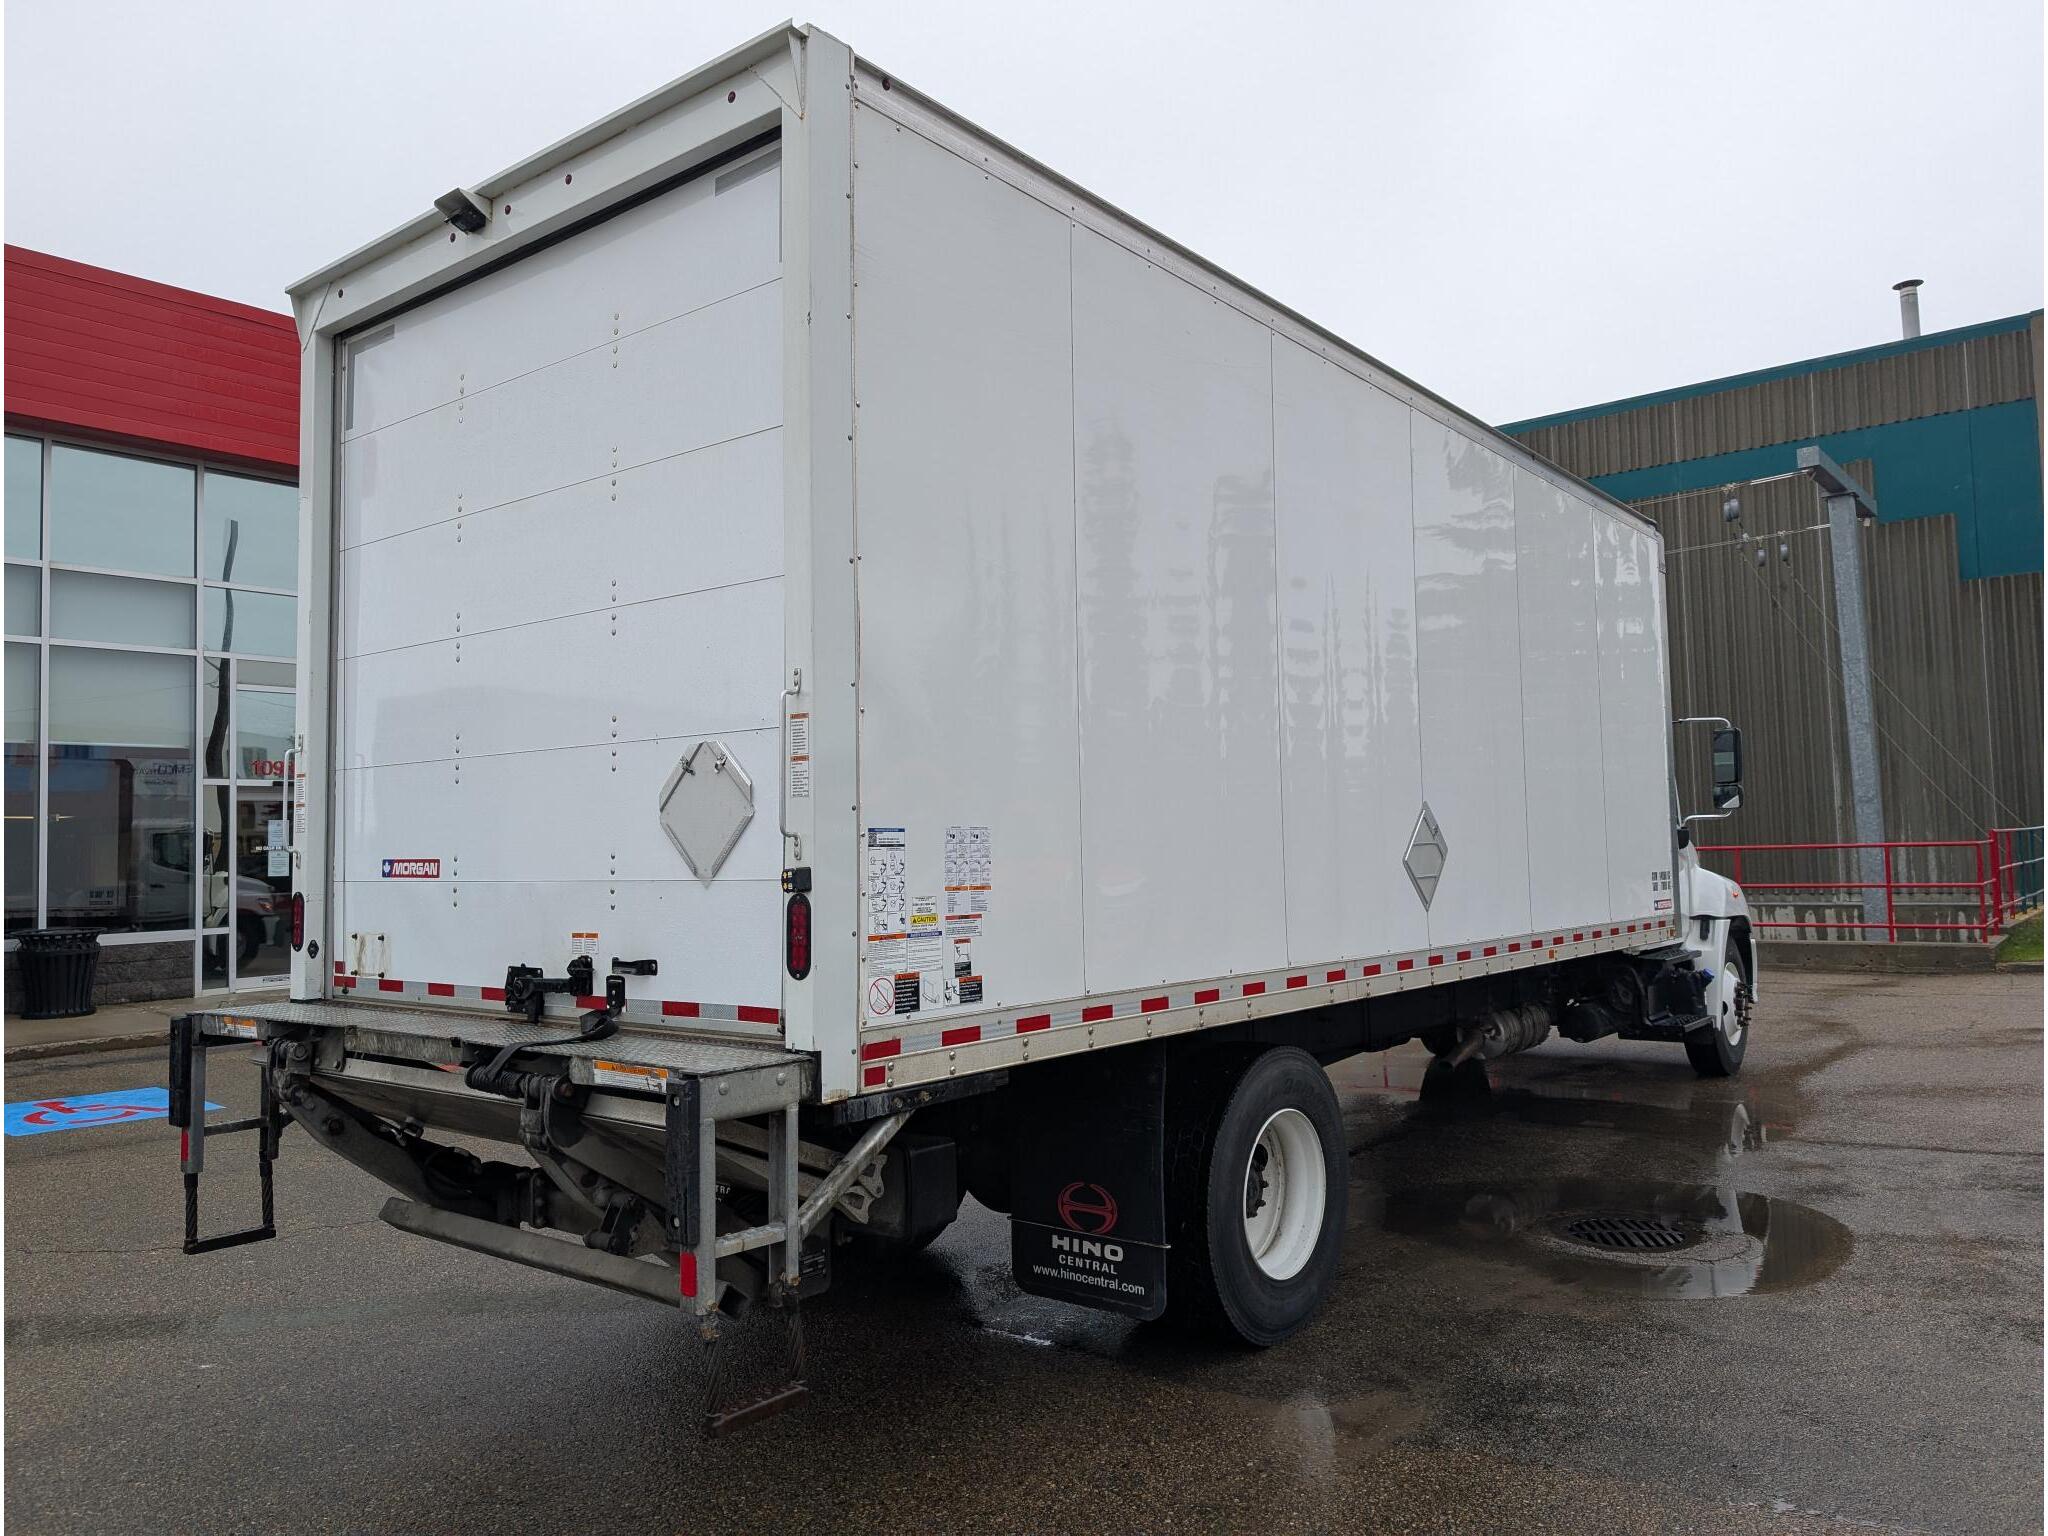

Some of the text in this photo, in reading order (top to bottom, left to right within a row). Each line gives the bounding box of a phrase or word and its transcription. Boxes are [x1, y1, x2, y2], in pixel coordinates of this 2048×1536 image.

[392, 862, 438, 876] MORGAN
[1051, 1234, 1124, 1262] HINO
[1058, 1254, 1118, 1275] CENTRAL
[1032, 1264, 1145, 1296] www.hinocentral.com
